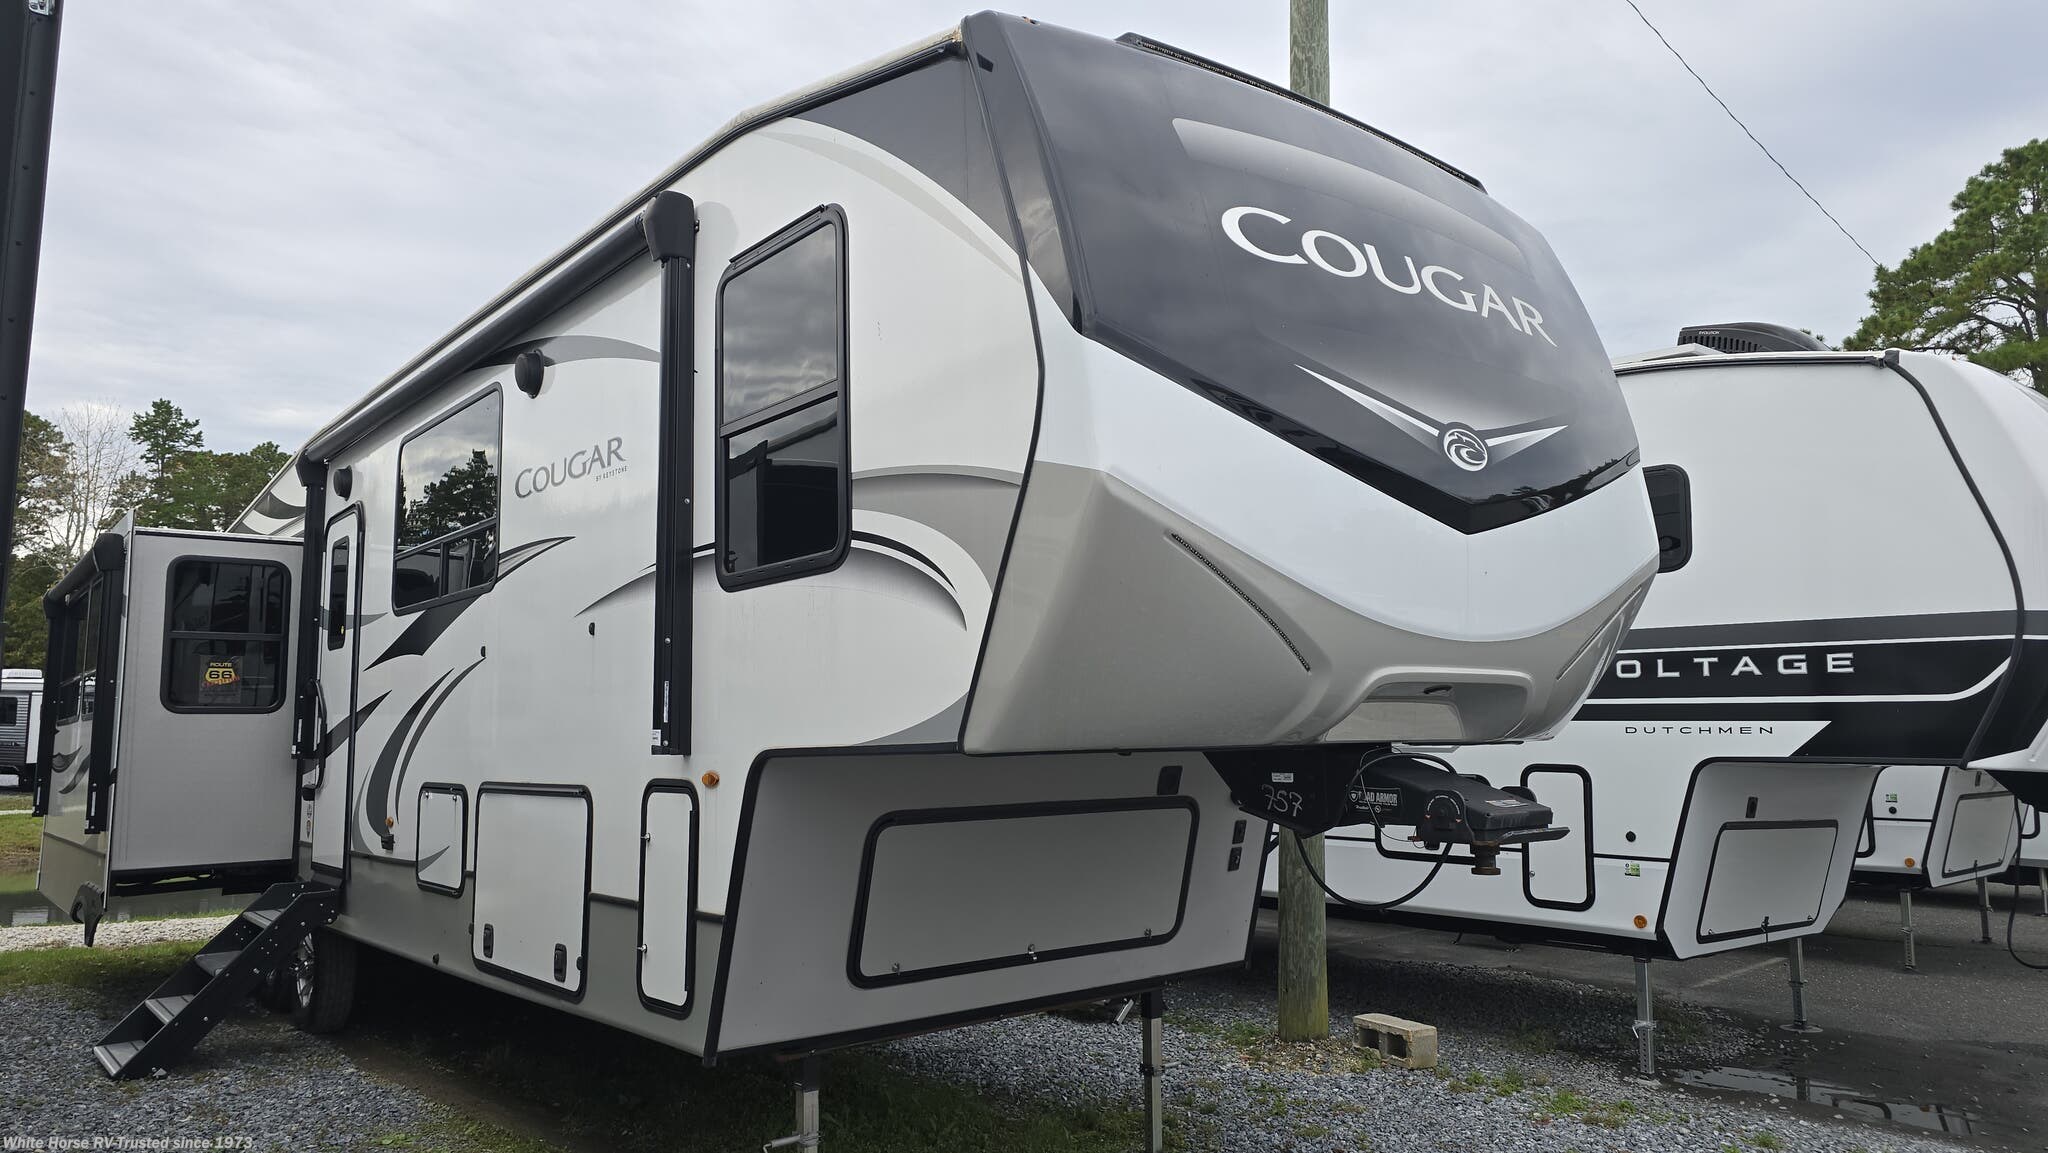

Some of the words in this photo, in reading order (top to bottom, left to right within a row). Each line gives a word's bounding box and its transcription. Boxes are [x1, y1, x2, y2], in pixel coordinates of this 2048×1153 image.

[1221, 206, 1557, 347] COUGAR
[515, 436, 626, 498] COUGAR
[209, 670, 233, 679] 66
[1616, 653, 1855, 679] OLTAGE
[1625, 726, 1774, 735] DUTCHMEN
[1261, 784, 1303, 817] 757
[1358, 791, 1375, 802] AD
[1375, 792, 1398, 805] ARMOR
